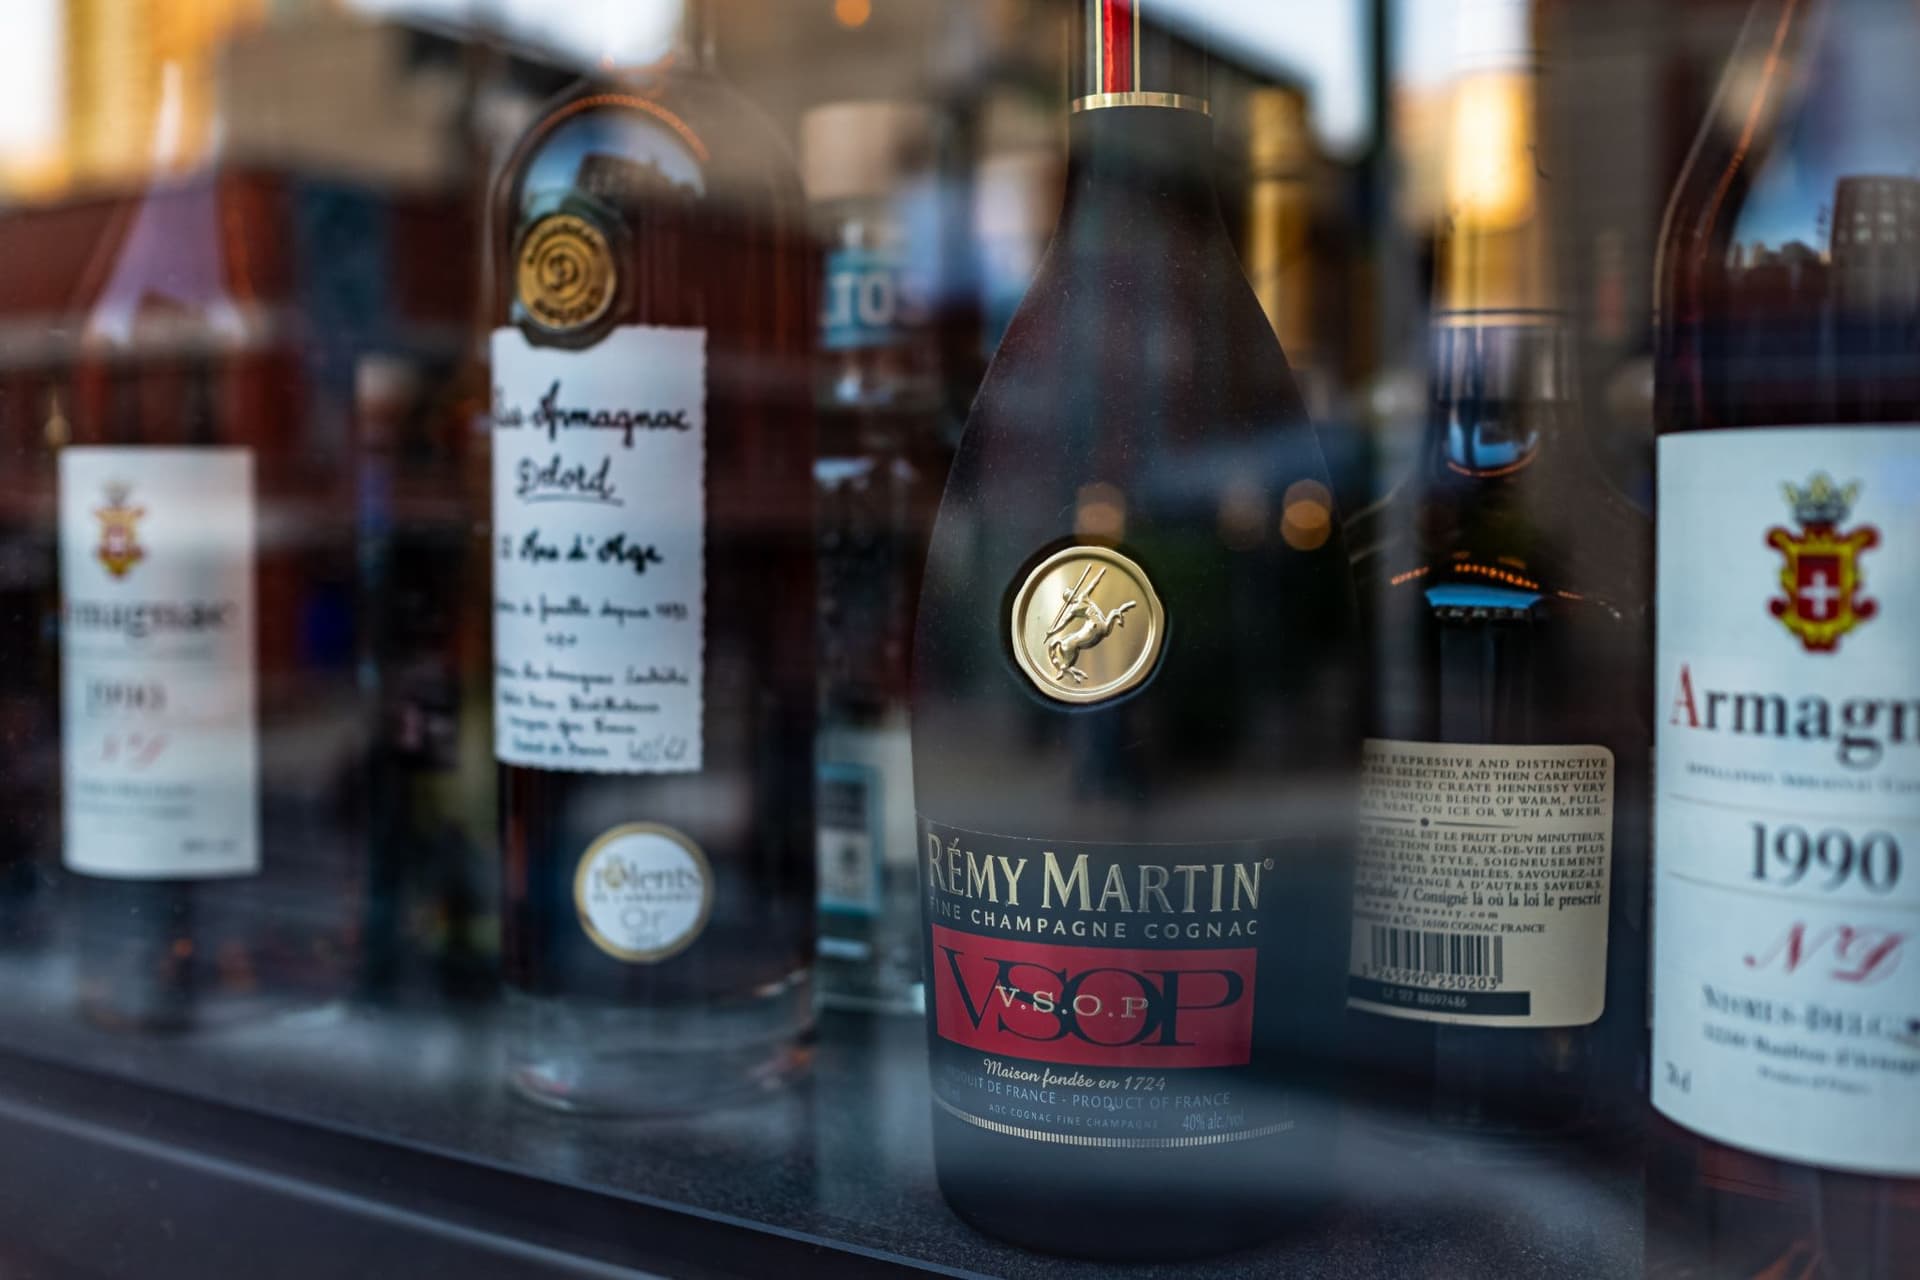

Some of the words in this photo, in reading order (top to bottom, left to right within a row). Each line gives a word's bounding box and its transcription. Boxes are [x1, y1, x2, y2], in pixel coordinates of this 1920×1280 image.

[1391, 755, 1473, 768] EXPRESSIVE
[1479, 757, 1510, 769] AND
[1516, 757, 1607, 769] DISTINCTIVE
[1461, 769, 1490, 781] AND
[1494, 770, 1530, 781] THEN
[1534, 770, 1607, 782] CAREFULLY
[1415, 779, 1433, 790] TO
[1438, 781, 1491, 793] CREATE
[1497, 783, 1569, 794] HENNESSY
[1574, 783, 1607, 794] VERY
[1391, 790, 1441, 804] UNIQUE
[1446, 794, 1491, 805] BLEND
[1496, 795, 1514, 806] OF
[1422, 804, 1442, 815] ON
[1448, 806, 1470, 817] ICE
[1475, 807, 1497, 817] OR
[1502, 807, 1540, 818] WITH
[1545, 808, 1553, 818] A
[1559, 807, 1605, 818] MIXER.
[1420, 830, 1439, 840] EST
[1443, 831, 1457, 842] LE
[1461, 832, 1497, 843] FRUIT
[1501, 832, 1533, 844] D'UN
[1537, 832, 1605, 844] MINUTIEUX
[1434, 842, 1457, 853] DES
[1462, 844, 1546, 855] EAUX-DE-VIE
[1551, 845, 1572, 856] LES
[1577, 844, 1605, 855] PLUS
[1391, 851, 1423, 863] LEUR
[1483, 856, 1605, 868] SOIGNEUSEMENT
[1750, 821, 1902, 896] 1990
[928, 832, 1028, 906] RÉMY
[1401, 863, 1427, 875] PUIS
[1517, 868, 1604, 880] SAVOUREZ-LE
[1470, 880, 1538, 891] D'AUTRES
[1413, 887, 1468, 908] Consigné
[1472, 890, 1484, 906] là
[1488, 892, 1503, 906] où
[1508, 891, 1519, 907] la
[1523, 890, 1540, 907] loi
[1544, 891, 1555, 907] le
[1559, 891, 1602, 911] prescrit
[971, 909, 1127, 938] CHAMPAGNE
[1144, 920, 1258, 939] COGNAC
[1450, 921, 1498, 933] COGNAC
[1500, 923, 1546, 934] FRANCE
[1438, 974, 1498, 990] 250203
[938, 944, 1244, 1047] VSOP
[983, 1058, 1041, 1083] Maison
[1041, 1067, 1097, 1089] fondée
[1098, 1077, 1121, 1090] en
[1123, 1075, 1168, 1092] 1724
[987, 1080, 1002, 1095] DE
[1005, 1084, 1057, 1105] FRANCE
[1072, 1094, 1145, 1111] PRODUCT
[1149, 1096, 1169, 1109] OF
[1175, 1091, 1232, 1109] FRANCE
[988, 1104, 1007, 1115] AOC
[1010, 1107, 1052, 1123] COGNAC
[1056, 1115, 1081, 1126] FINE
